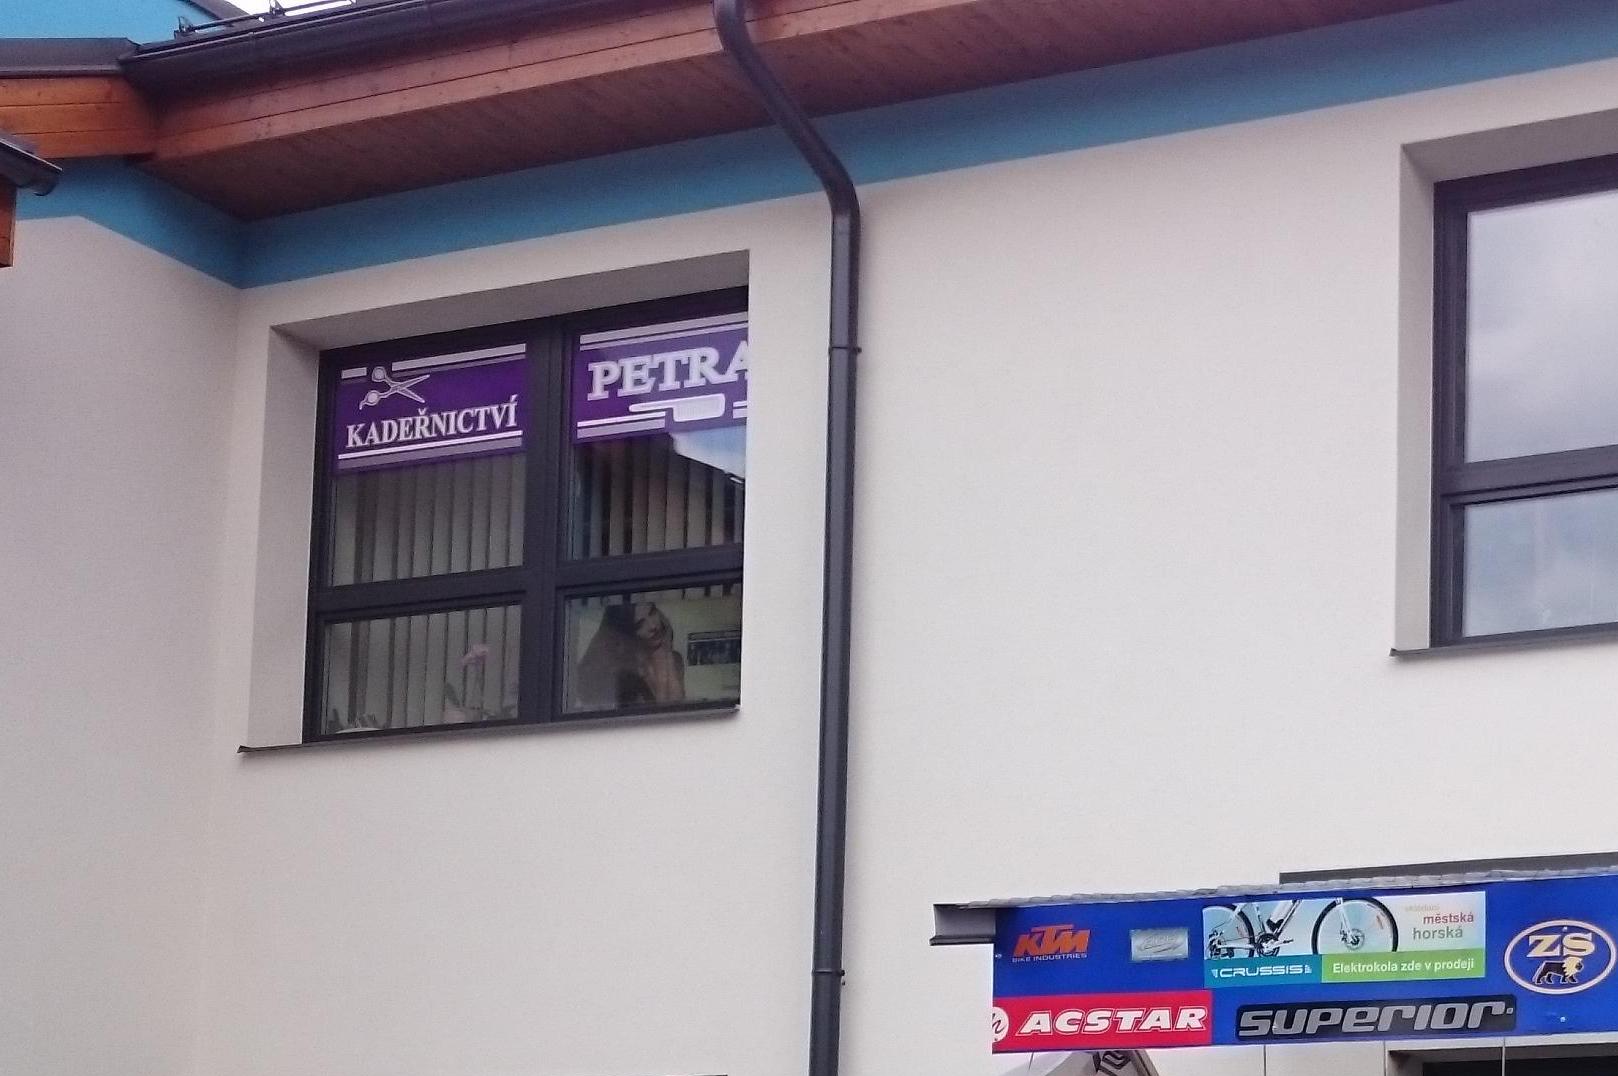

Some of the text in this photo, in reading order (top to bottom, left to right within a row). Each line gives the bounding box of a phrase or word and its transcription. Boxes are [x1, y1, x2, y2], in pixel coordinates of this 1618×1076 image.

[587, 340, 748, 401] PETRA
[346, 394, 518, 449] KADEŘNICTVÍ
[1422, 912, 1475, 925] městská
[1012, 924, 1091, 956] KTM
[1412, 926, 1464, 940] horská
[1526, 932, 1597, 959] ZS
[1033, 953, 1088, 962] INDUSTRIES
[1332, 958, 1475, 974] Elektrokola zde v prodeji
[1219, 964, 1304, 978] CRUSSIS
[1015, 1006, 1208, 1036] ACSTAR
